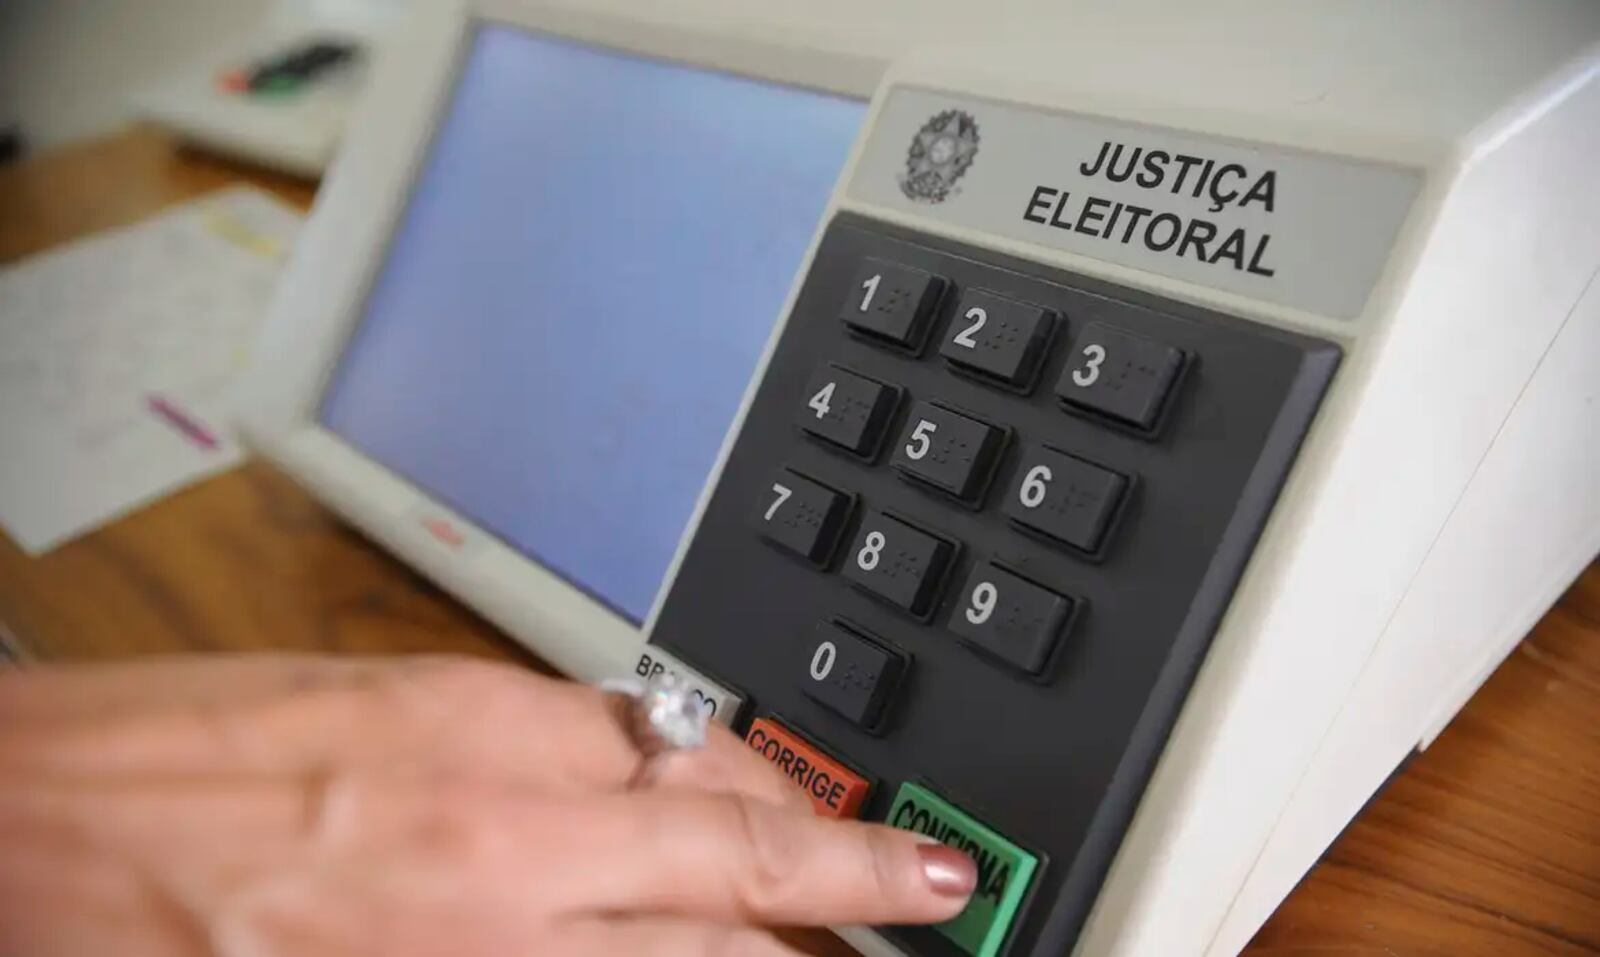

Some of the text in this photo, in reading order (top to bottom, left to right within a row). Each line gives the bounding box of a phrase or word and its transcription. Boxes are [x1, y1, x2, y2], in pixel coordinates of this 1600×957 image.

[1080, 142, 1275, 212] JUSTIÇA
[1024, 186, 1274, 277] ELEITORAL
[861, 275, 881, 311] 1
[954, 308, 986, 348] 2
[1073, 345, 1105, 386] 3
[809, 383, 835, 418] 4
[906, 420, 936, 459] 5
[765, 484, 792, 520] 7
[1020, 466, 1051, 507] 6
[858, 531, 885, 570] 8
[966, 582, 997, 624] 9
[811, 642, 835, 680] 0
[636, 653, 717, 718] BRO
[748, 728, 846, 810] CORRIGE
